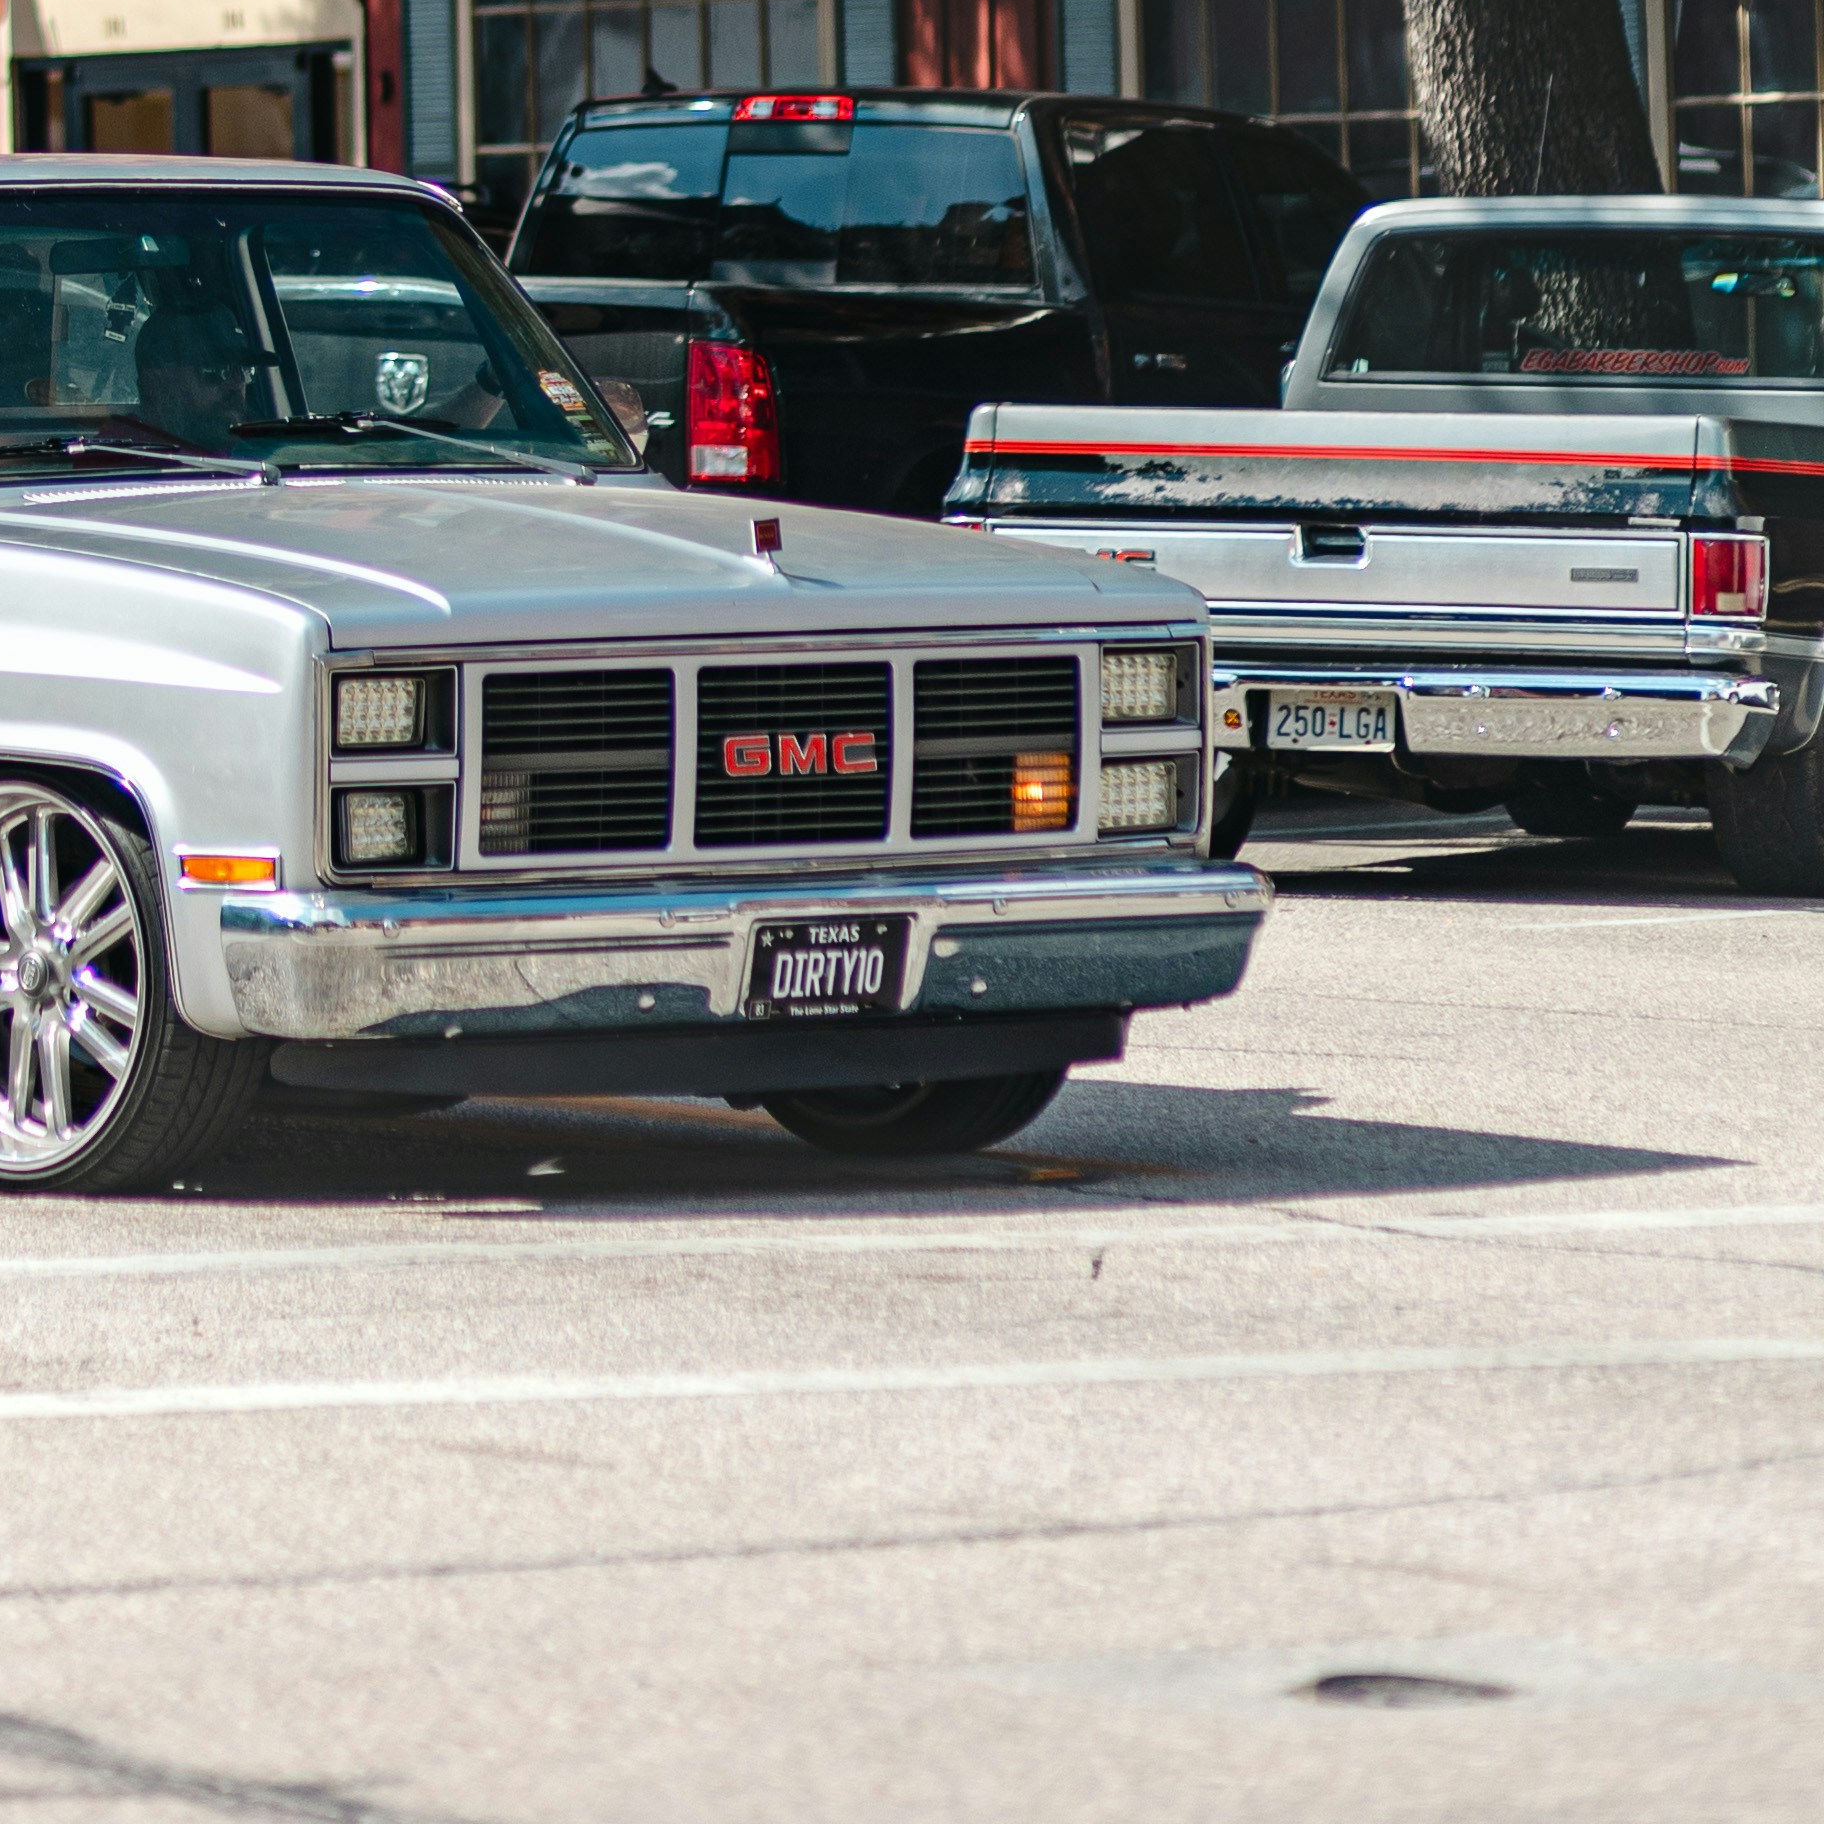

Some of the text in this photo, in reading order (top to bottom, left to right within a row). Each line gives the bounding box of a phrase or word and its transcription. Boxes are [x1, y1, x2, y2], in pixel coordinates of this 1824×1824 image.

[724, 732, 878, 777] GMC
[808, 925, 861, 945] TEXAS
[772, 948, 885, 999] DIRTY10
